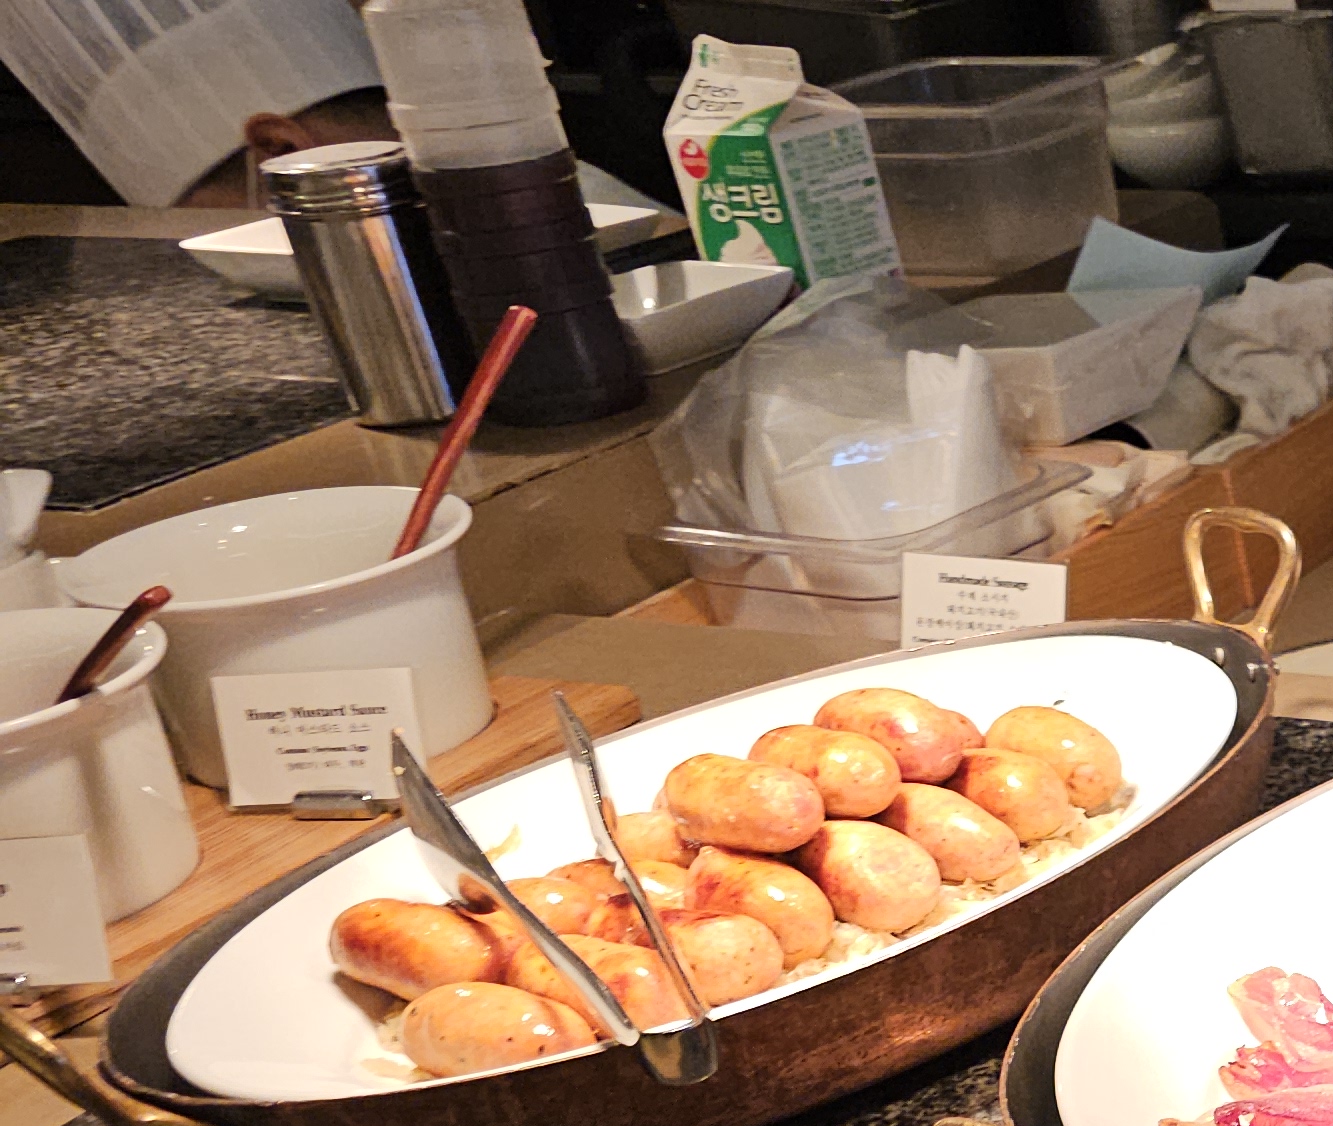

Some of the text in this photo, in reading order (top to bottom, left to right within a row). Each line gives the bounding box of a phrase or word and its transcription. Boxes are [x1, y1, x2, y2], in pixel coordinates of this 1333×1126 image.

[693, 78, 739, 98] Fresh
[682, 94, 744, 112] Cream
[701, 182, 784, 224] 생크림
